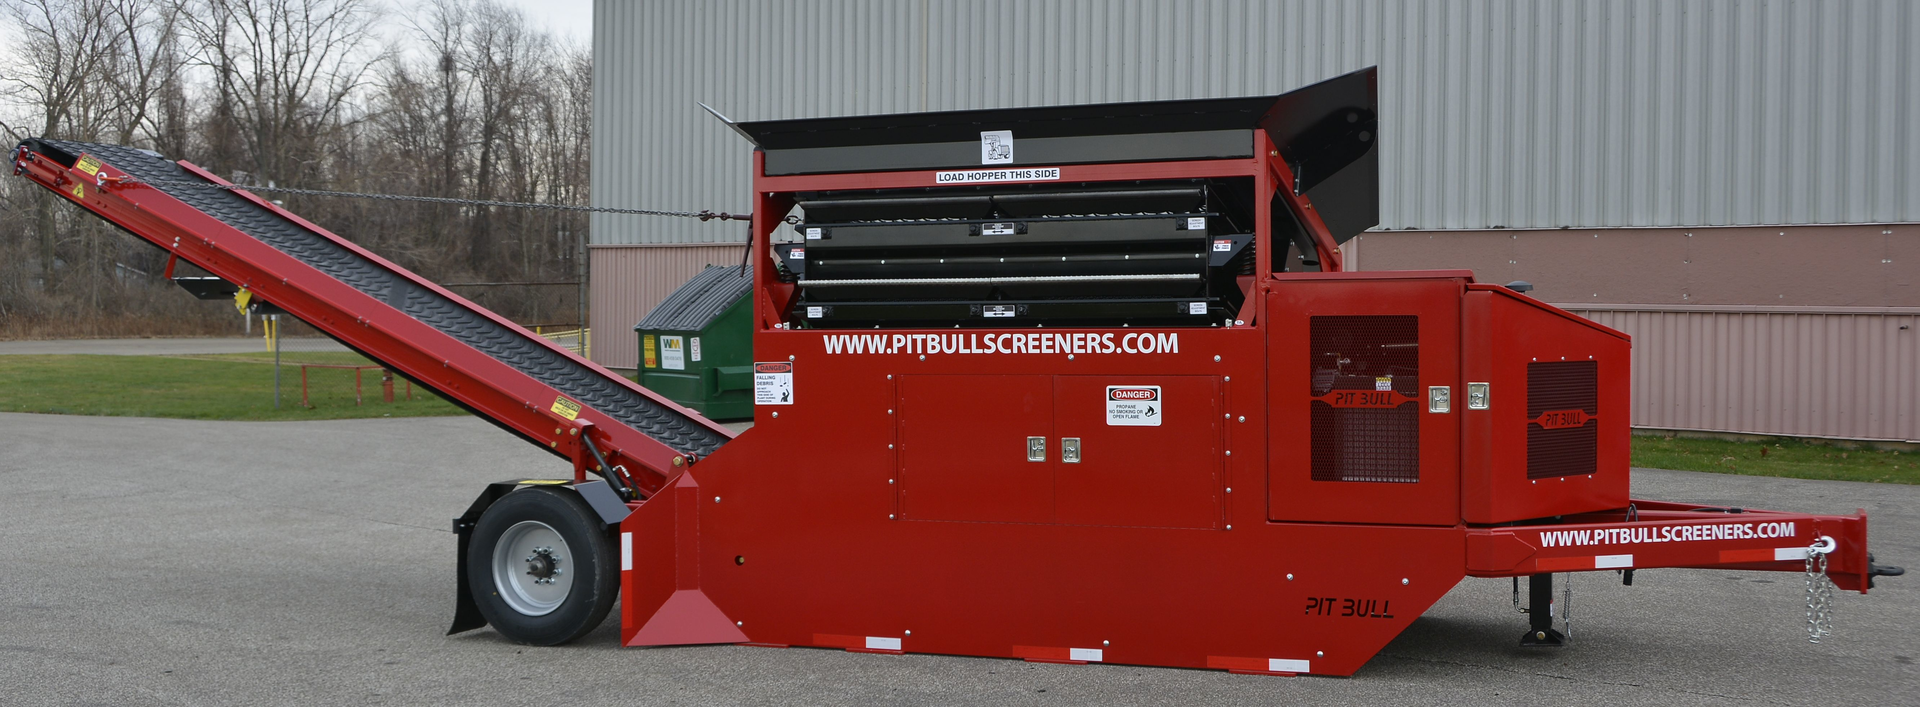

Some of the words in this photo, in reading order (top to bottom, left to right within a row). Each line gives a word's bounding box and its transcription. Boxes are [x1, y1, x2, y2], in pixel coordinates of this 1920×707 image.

[939, 173, 965, 182] LOAD
[967, 171, 1007, 181] HOPPER
[1010, 170, 1032, 179] THIS
[1034, 169, 1058, 178] SIDE
[662, 338, 680, 349] WM
[823, 332, 1179, 354] WWW.PITBULLSCREENERS.COM
[556, 396, 580, 412] CAUTION
[1336, 392, 1356, 405] PIT
[1360, 392, 1394, 406] BULL
[1546, 413, 1559, 426] PIT
[1561, 412, 1582, 425] BULL
[1540, 522, 1796, 547] WWW.PITBULLSCREENERS.COM
[1305, 597, 1337, 616] PIT
[1342, 598, 1394, 619] BULL
